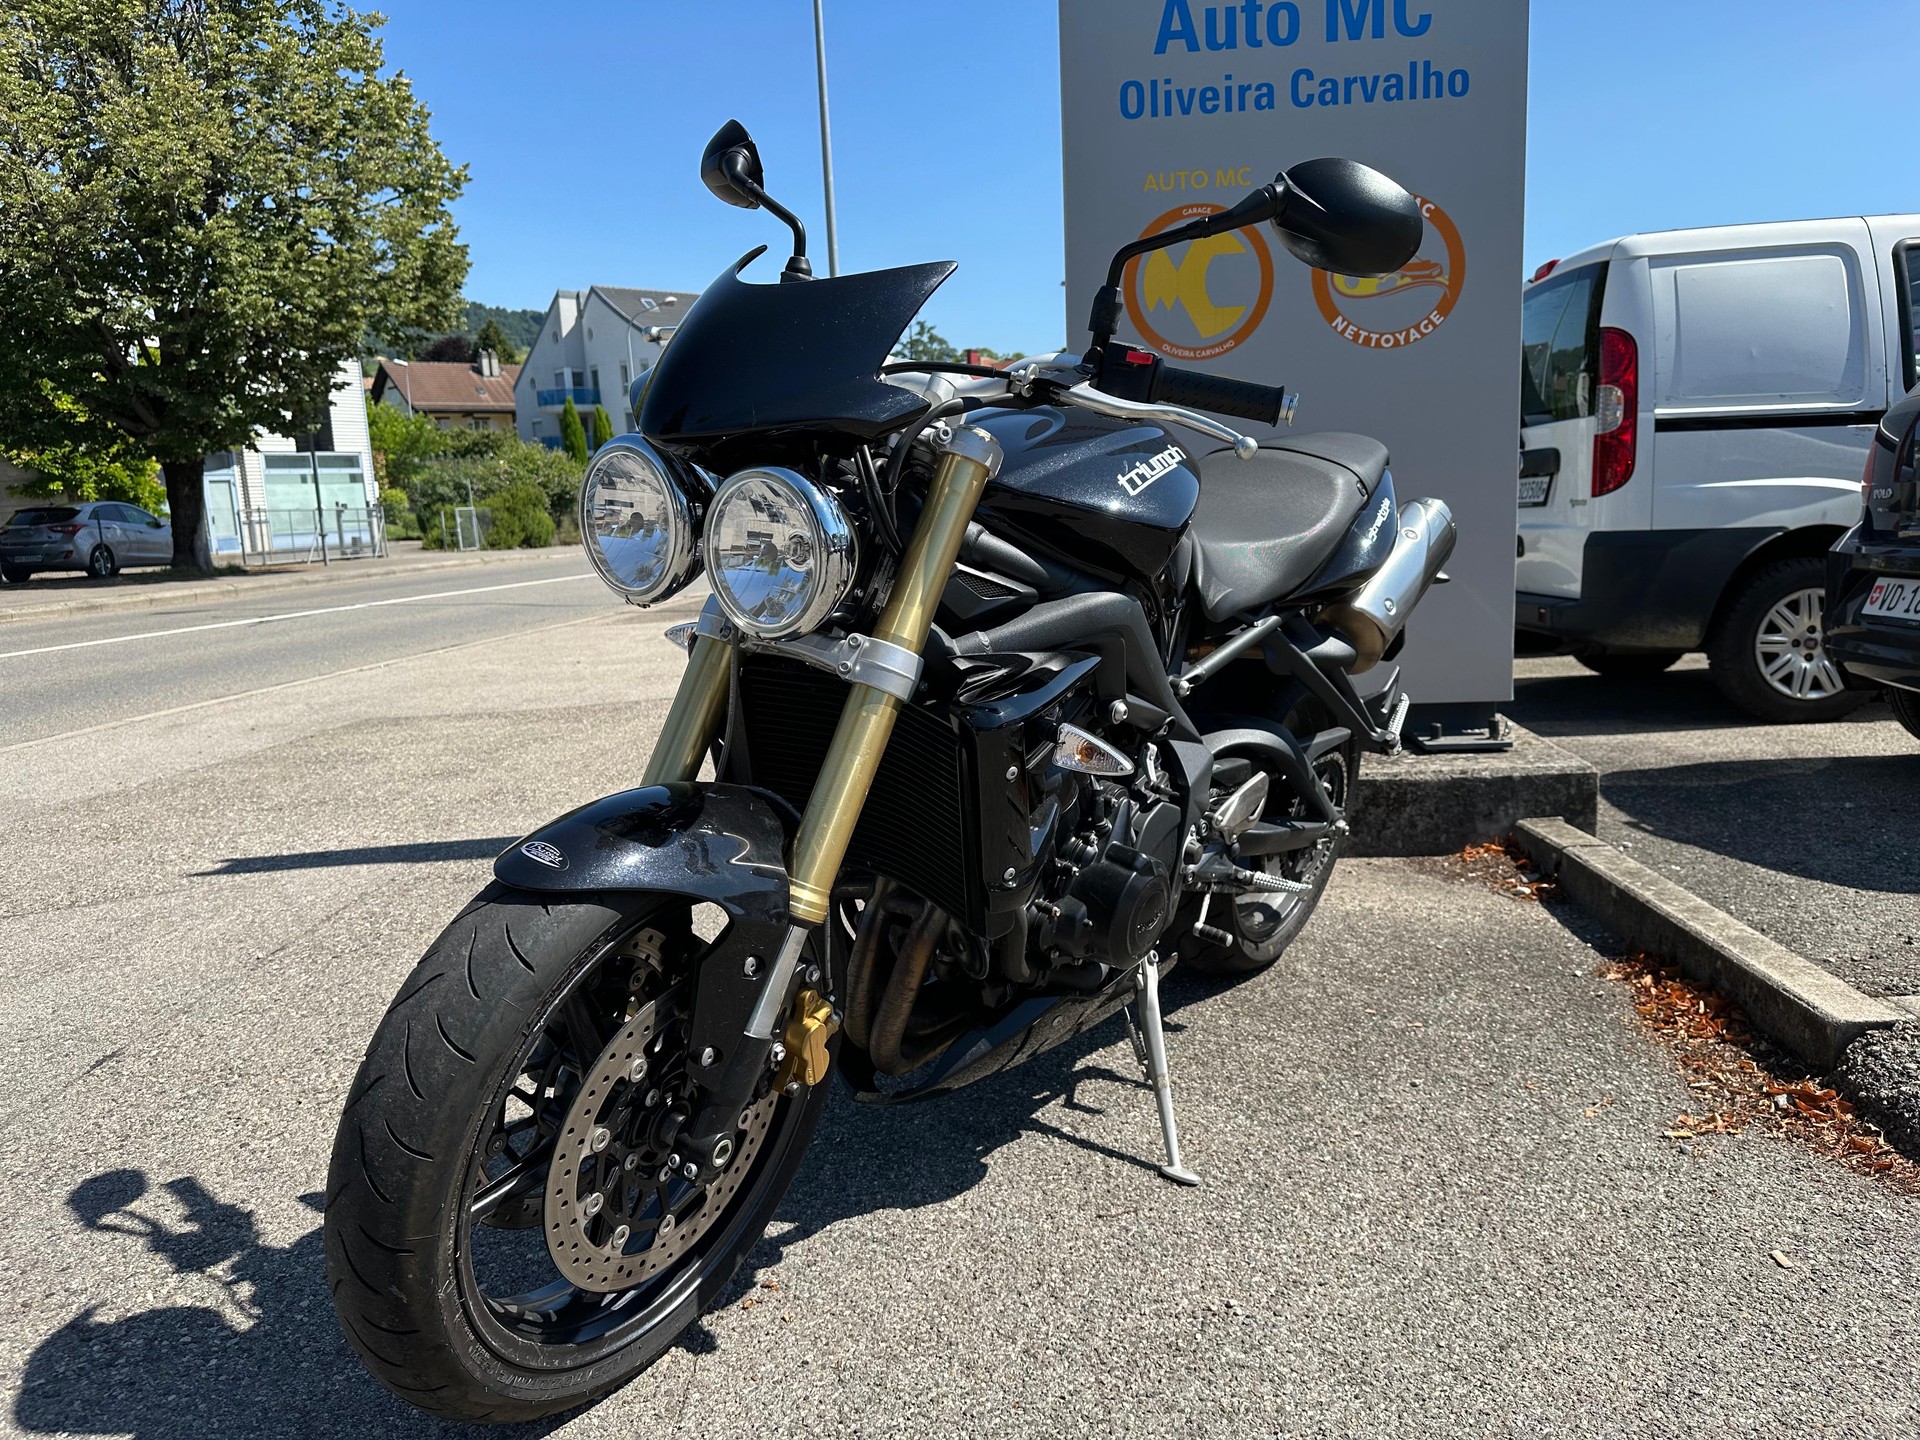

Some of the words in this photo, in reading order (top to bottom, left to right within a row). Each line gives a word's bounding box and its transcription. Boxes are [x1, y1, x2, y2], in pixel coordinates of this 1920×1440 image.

[1153, 0, 1301, 55] Auto
[1325, 0, 1433, 43] MC
[1119, 74, 1275, 120] Oliveira
[1290, 60, 1470, 108] Carvalho
[1143, 168, 1209, 192] AUTO
[1215, 166, 1252, 187] MC
[1182, 206, 1213, 216] GARAGE
[1331, 310, 1445, 348] NETTOYAGE
[1162, 343, 1195, 358] OLIVEIRA
[1195, 339, 1236, 358] CARVALHO
[1873, 487, 1893, 500] POLO
